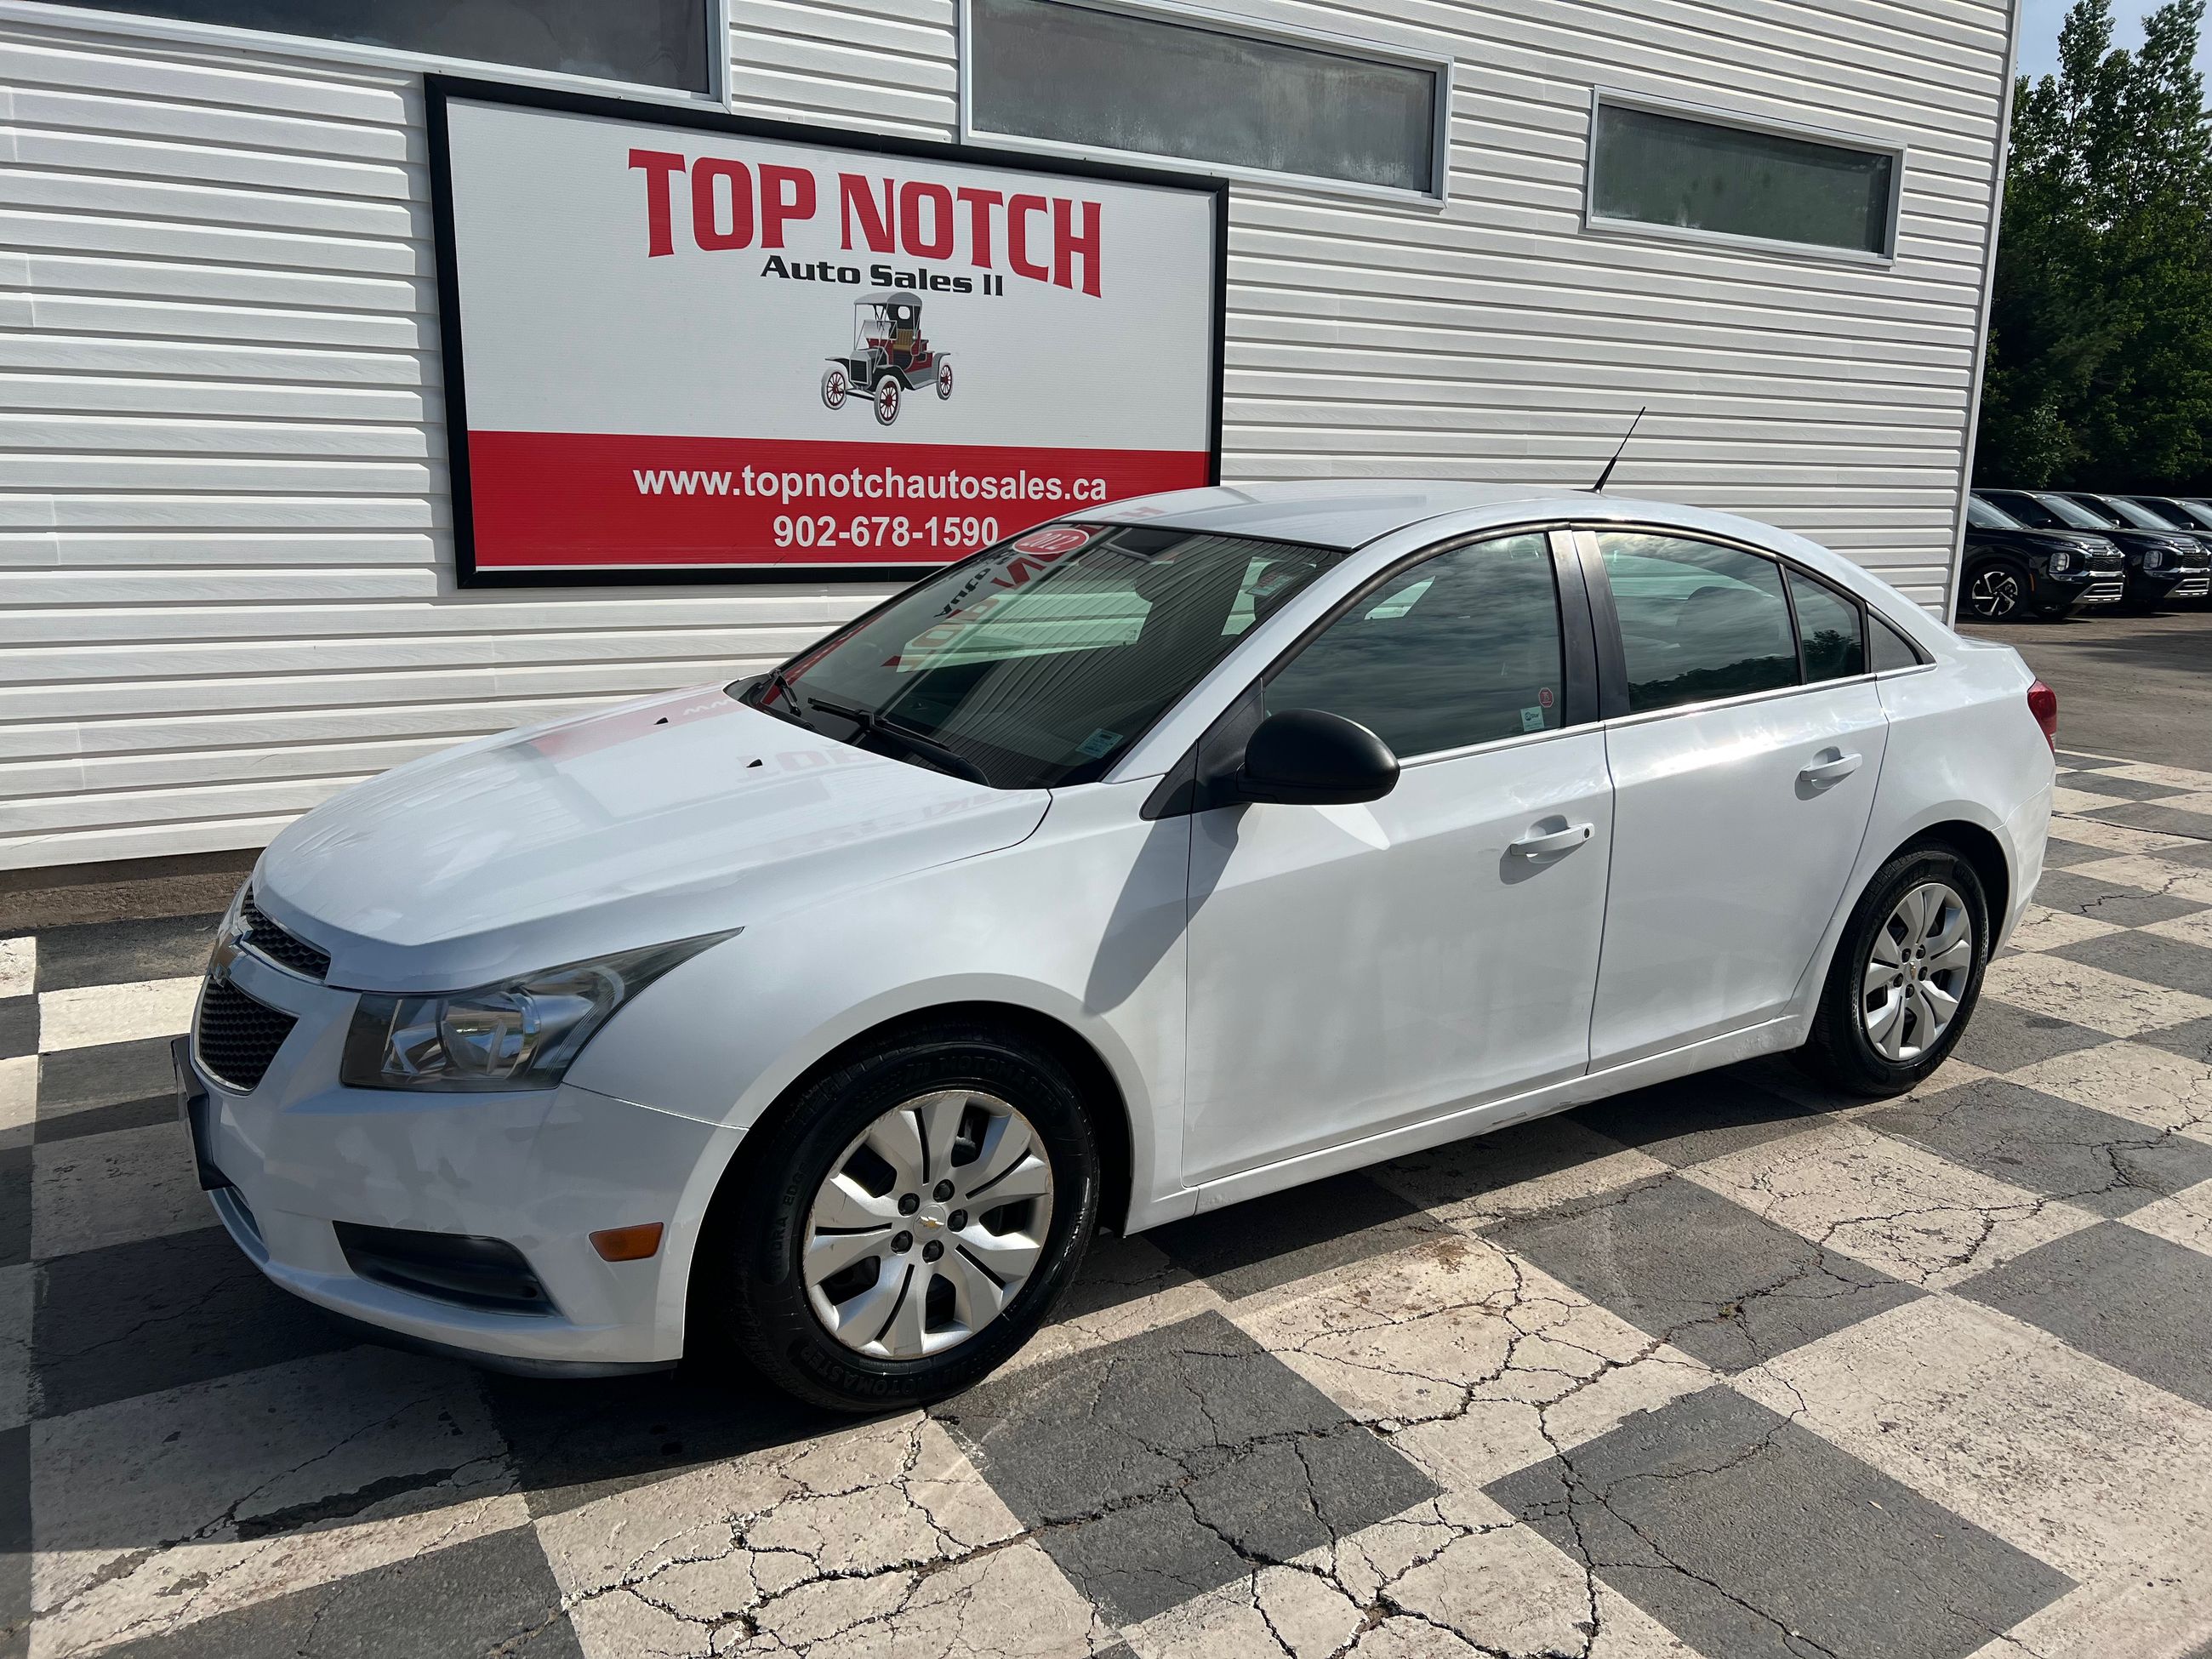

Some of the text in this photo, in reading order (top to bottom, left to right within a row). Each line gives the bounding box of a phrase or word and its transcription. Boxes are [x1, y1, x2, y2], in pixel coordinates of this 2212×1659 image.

[628, 148, 1102, 299] TOP NOTCH
[760, 254, 1004, 297] Auto Sales II
[633, 465, 1107, 504] www.topnotchautosales.ca
[772, 514, 999, 548] 902-678-1590
[1019, 533, 1080, 550] 2012
